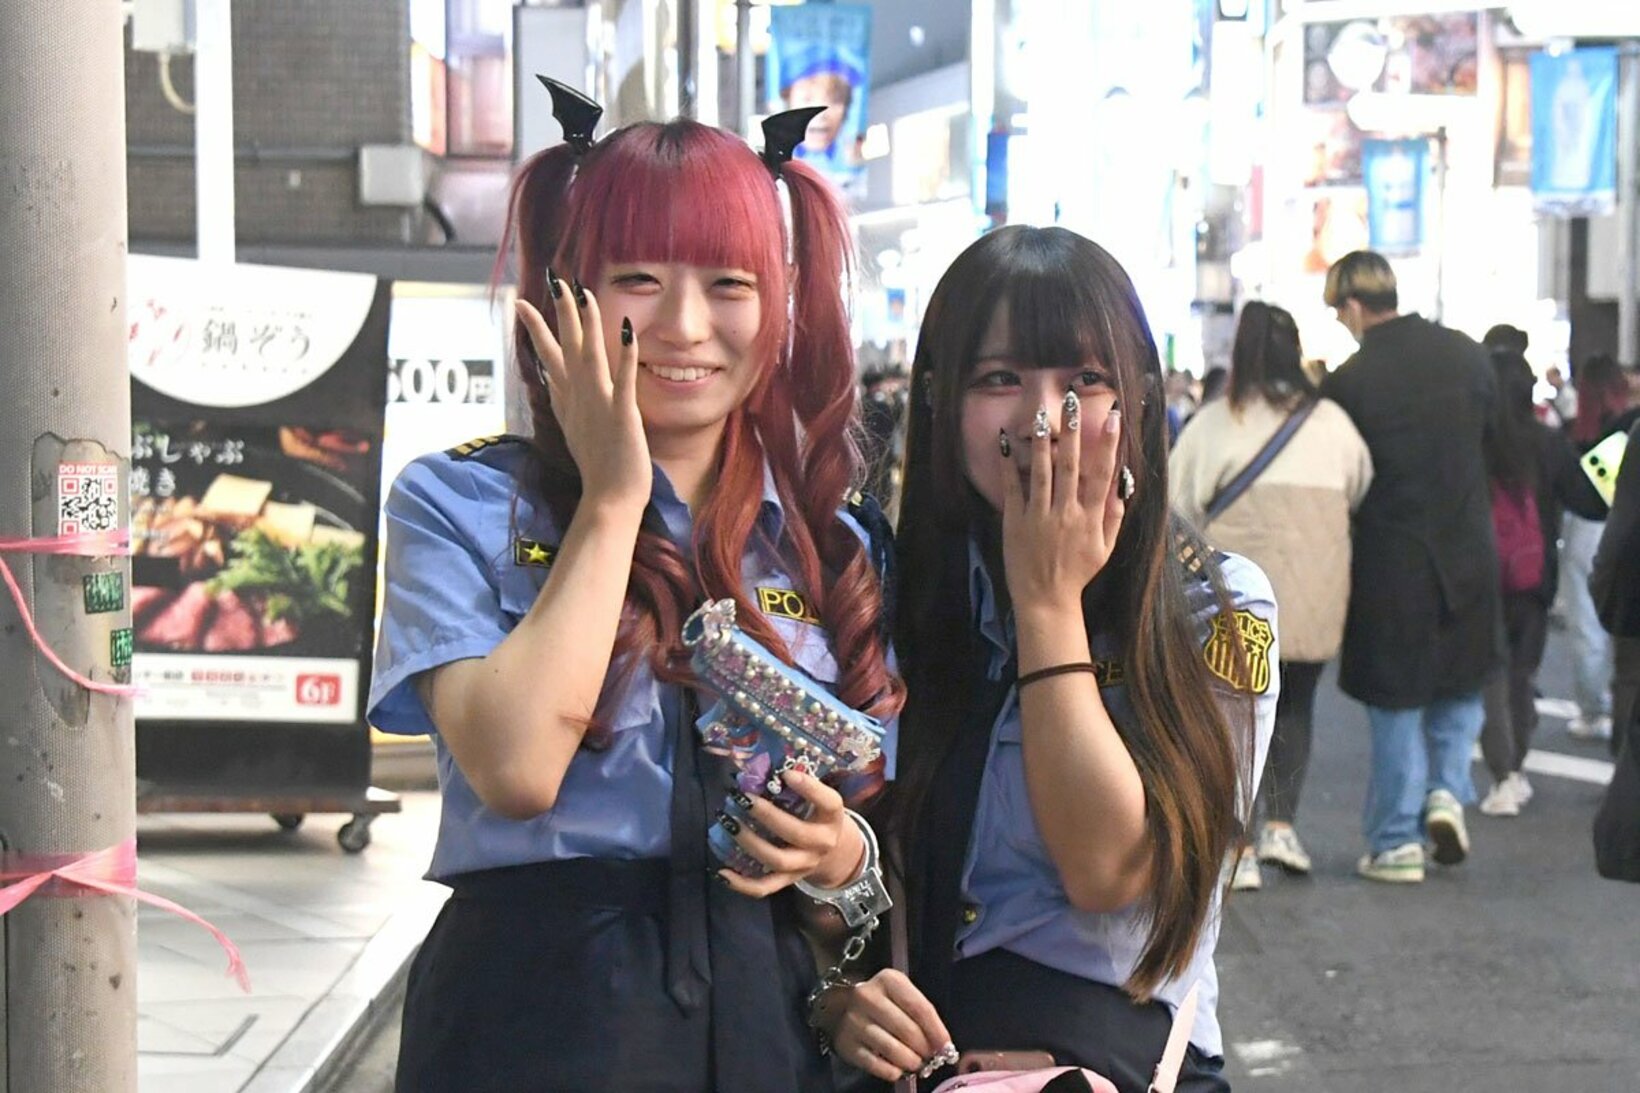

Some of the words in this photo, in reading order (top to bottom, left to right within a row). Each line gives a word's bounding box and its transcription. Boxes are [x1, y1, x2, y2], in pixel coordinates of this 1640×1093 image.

[202, 318, 312, 362] 鍋ぞう
[59, 464, 76, 474] DO
[76, 464, 97, 474] NOT
[300, 675, 337, 704] 6F
